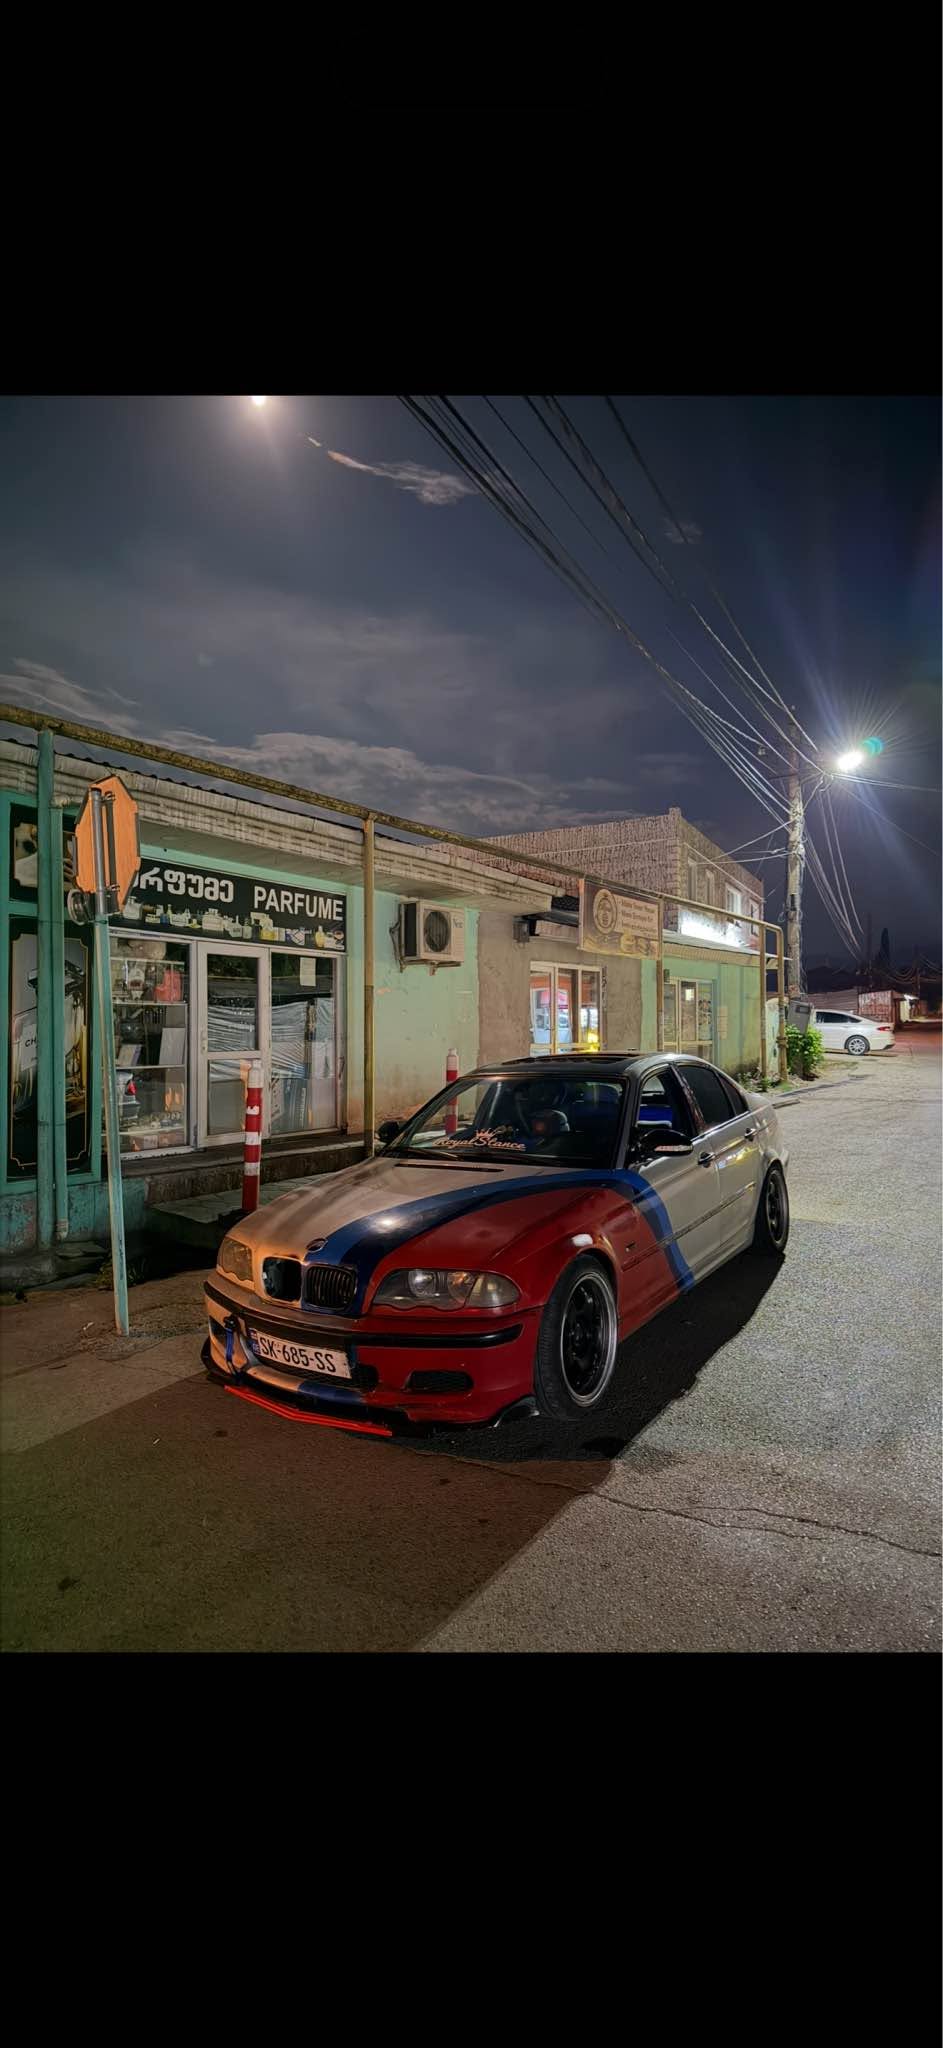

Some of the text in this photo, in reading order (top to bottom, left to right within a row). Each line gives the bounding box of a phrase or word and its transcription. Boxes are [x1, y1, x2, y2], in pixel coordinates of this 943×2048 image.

[134, 866, 343, 921] რფუმე PARFUME
[260, 1337, 336, 1373] SK-685-SS
